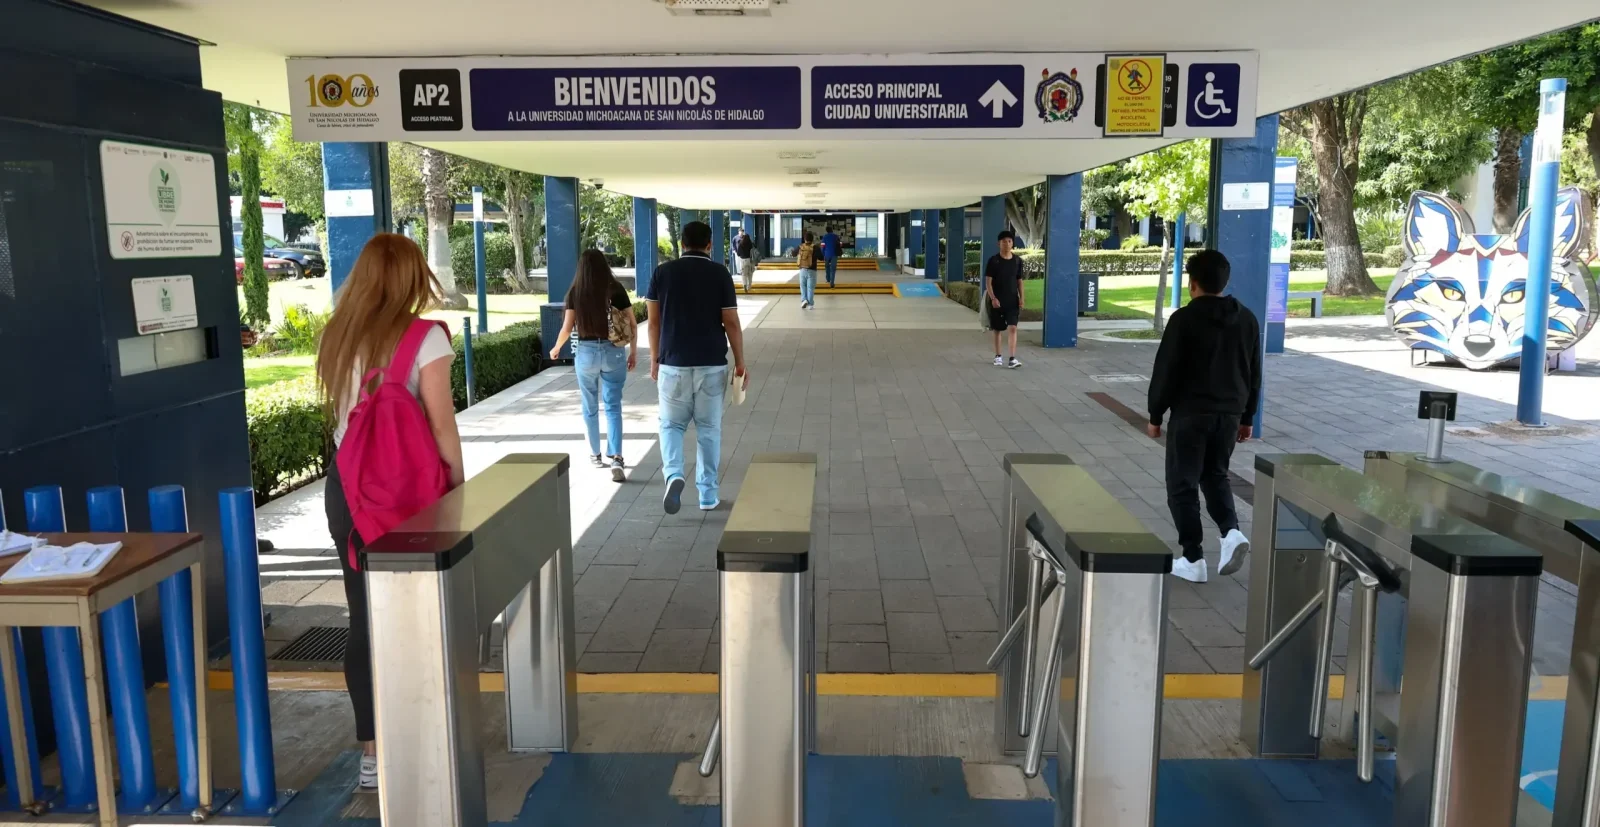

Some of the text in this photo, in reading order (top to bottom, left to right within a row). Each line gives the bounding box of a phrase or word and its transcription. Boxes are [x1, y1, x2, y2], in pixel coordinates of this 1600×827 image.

[352, 84, 380, 98] años
[413, 84, 450, 106] AP2
[554, 76, 716, 106] BIENVENIDOS
[824, 83, 942, 98] ACCESO PRINCIPAL
[508, 108, 764, 121] A LA UNIVERSIDAD MICHOACANA DE SAN NICOLÁS DE HIDALGO
[824, 104, 968, 119] CIUDAD UNIVERSITARIA
[570, 326, 579, 354] URA
